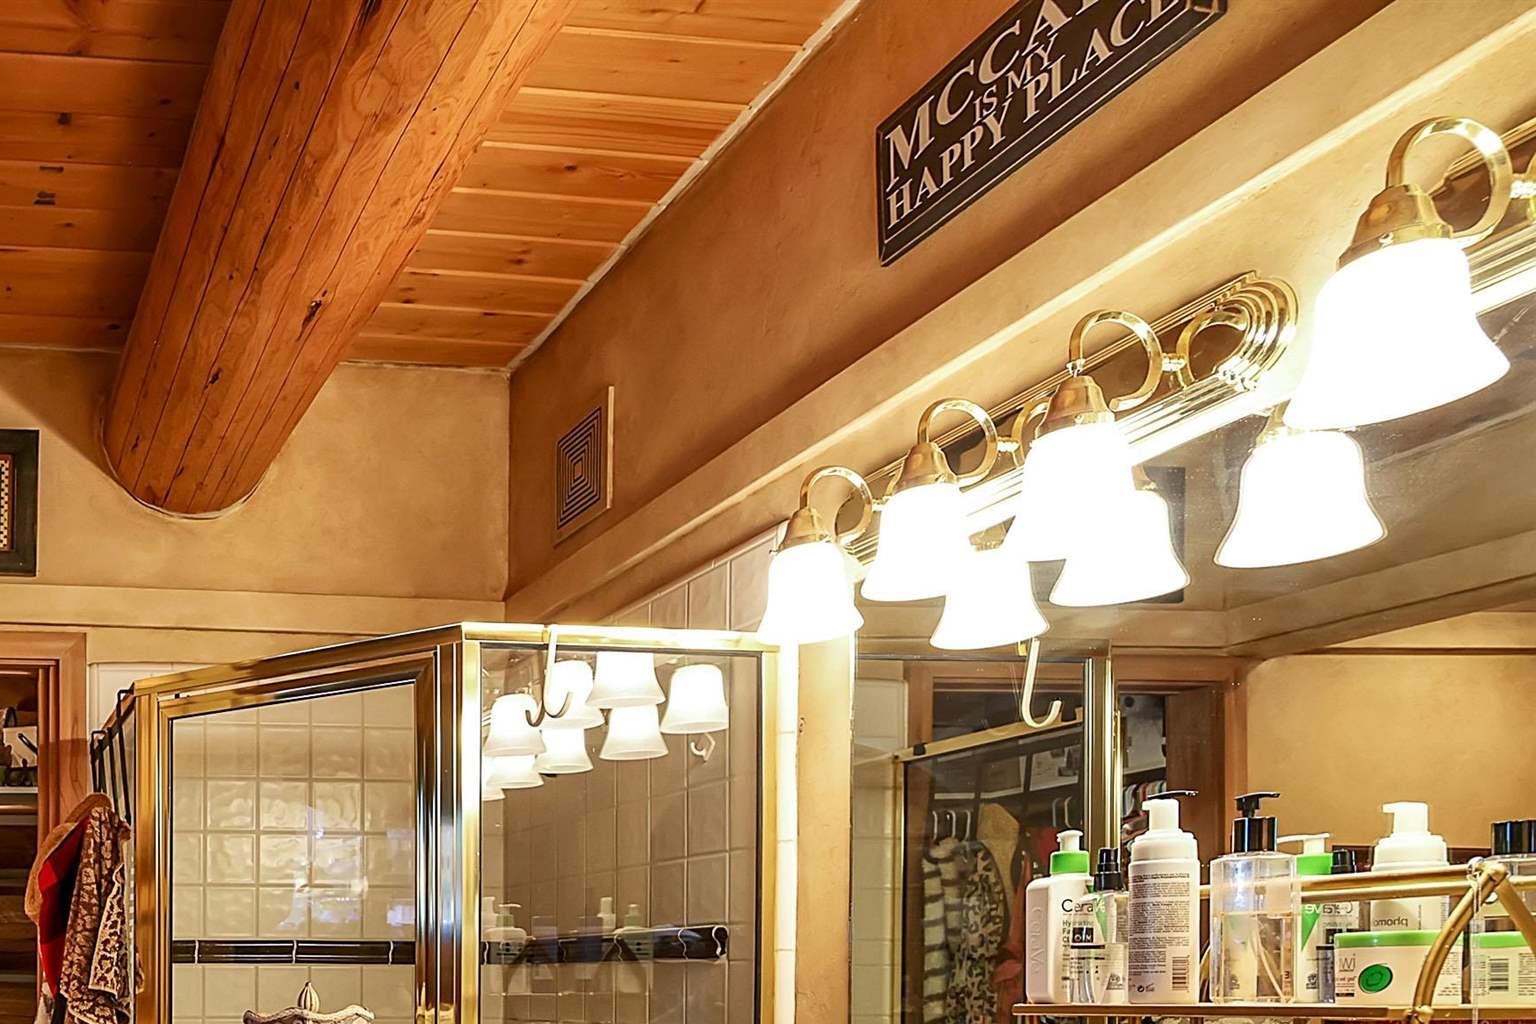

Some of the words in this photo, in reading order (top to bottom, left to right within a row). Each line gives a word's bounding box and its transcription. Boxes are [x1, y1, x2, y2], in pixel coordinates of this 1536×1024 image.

[885, 0, 1104, 192] MCCA
[972, 85, 998, 126] IS
[1005, 33, 1058, 98] MY
[887, 98, 1012, 230] HAPPY
